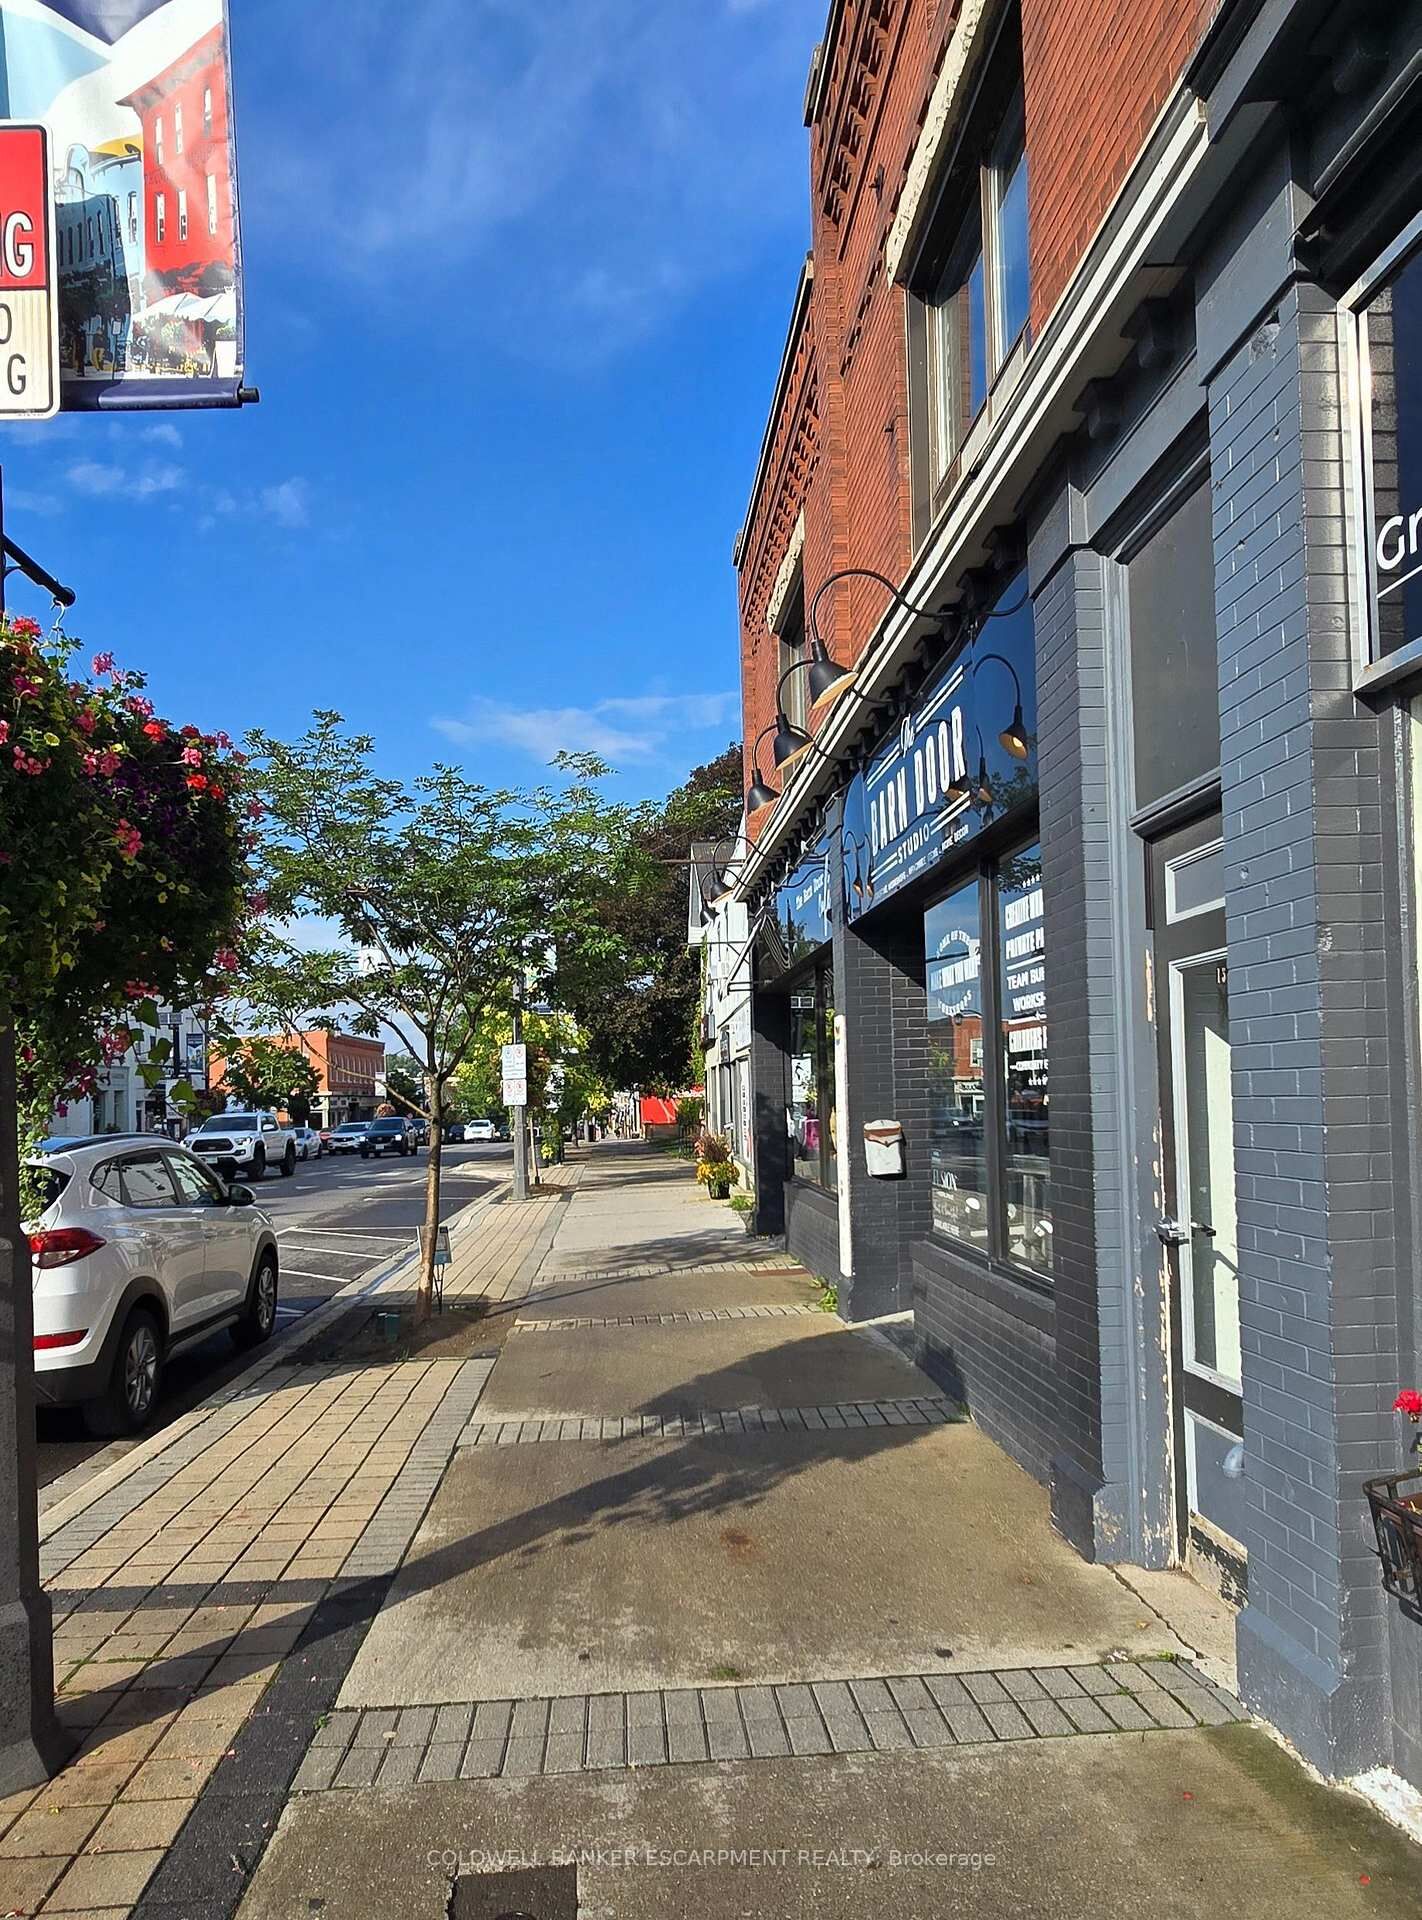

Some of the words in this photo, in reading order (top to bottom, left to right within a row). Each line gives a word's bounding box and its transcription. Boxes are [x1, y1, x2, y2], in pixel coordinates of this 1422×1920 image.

[870, 766, 908, 857] BARN
[914, 705, 966, 816] DOOR
[897, 823, 930, 864] STUDIO
[1006, 970, 1029, 990] TEAM
